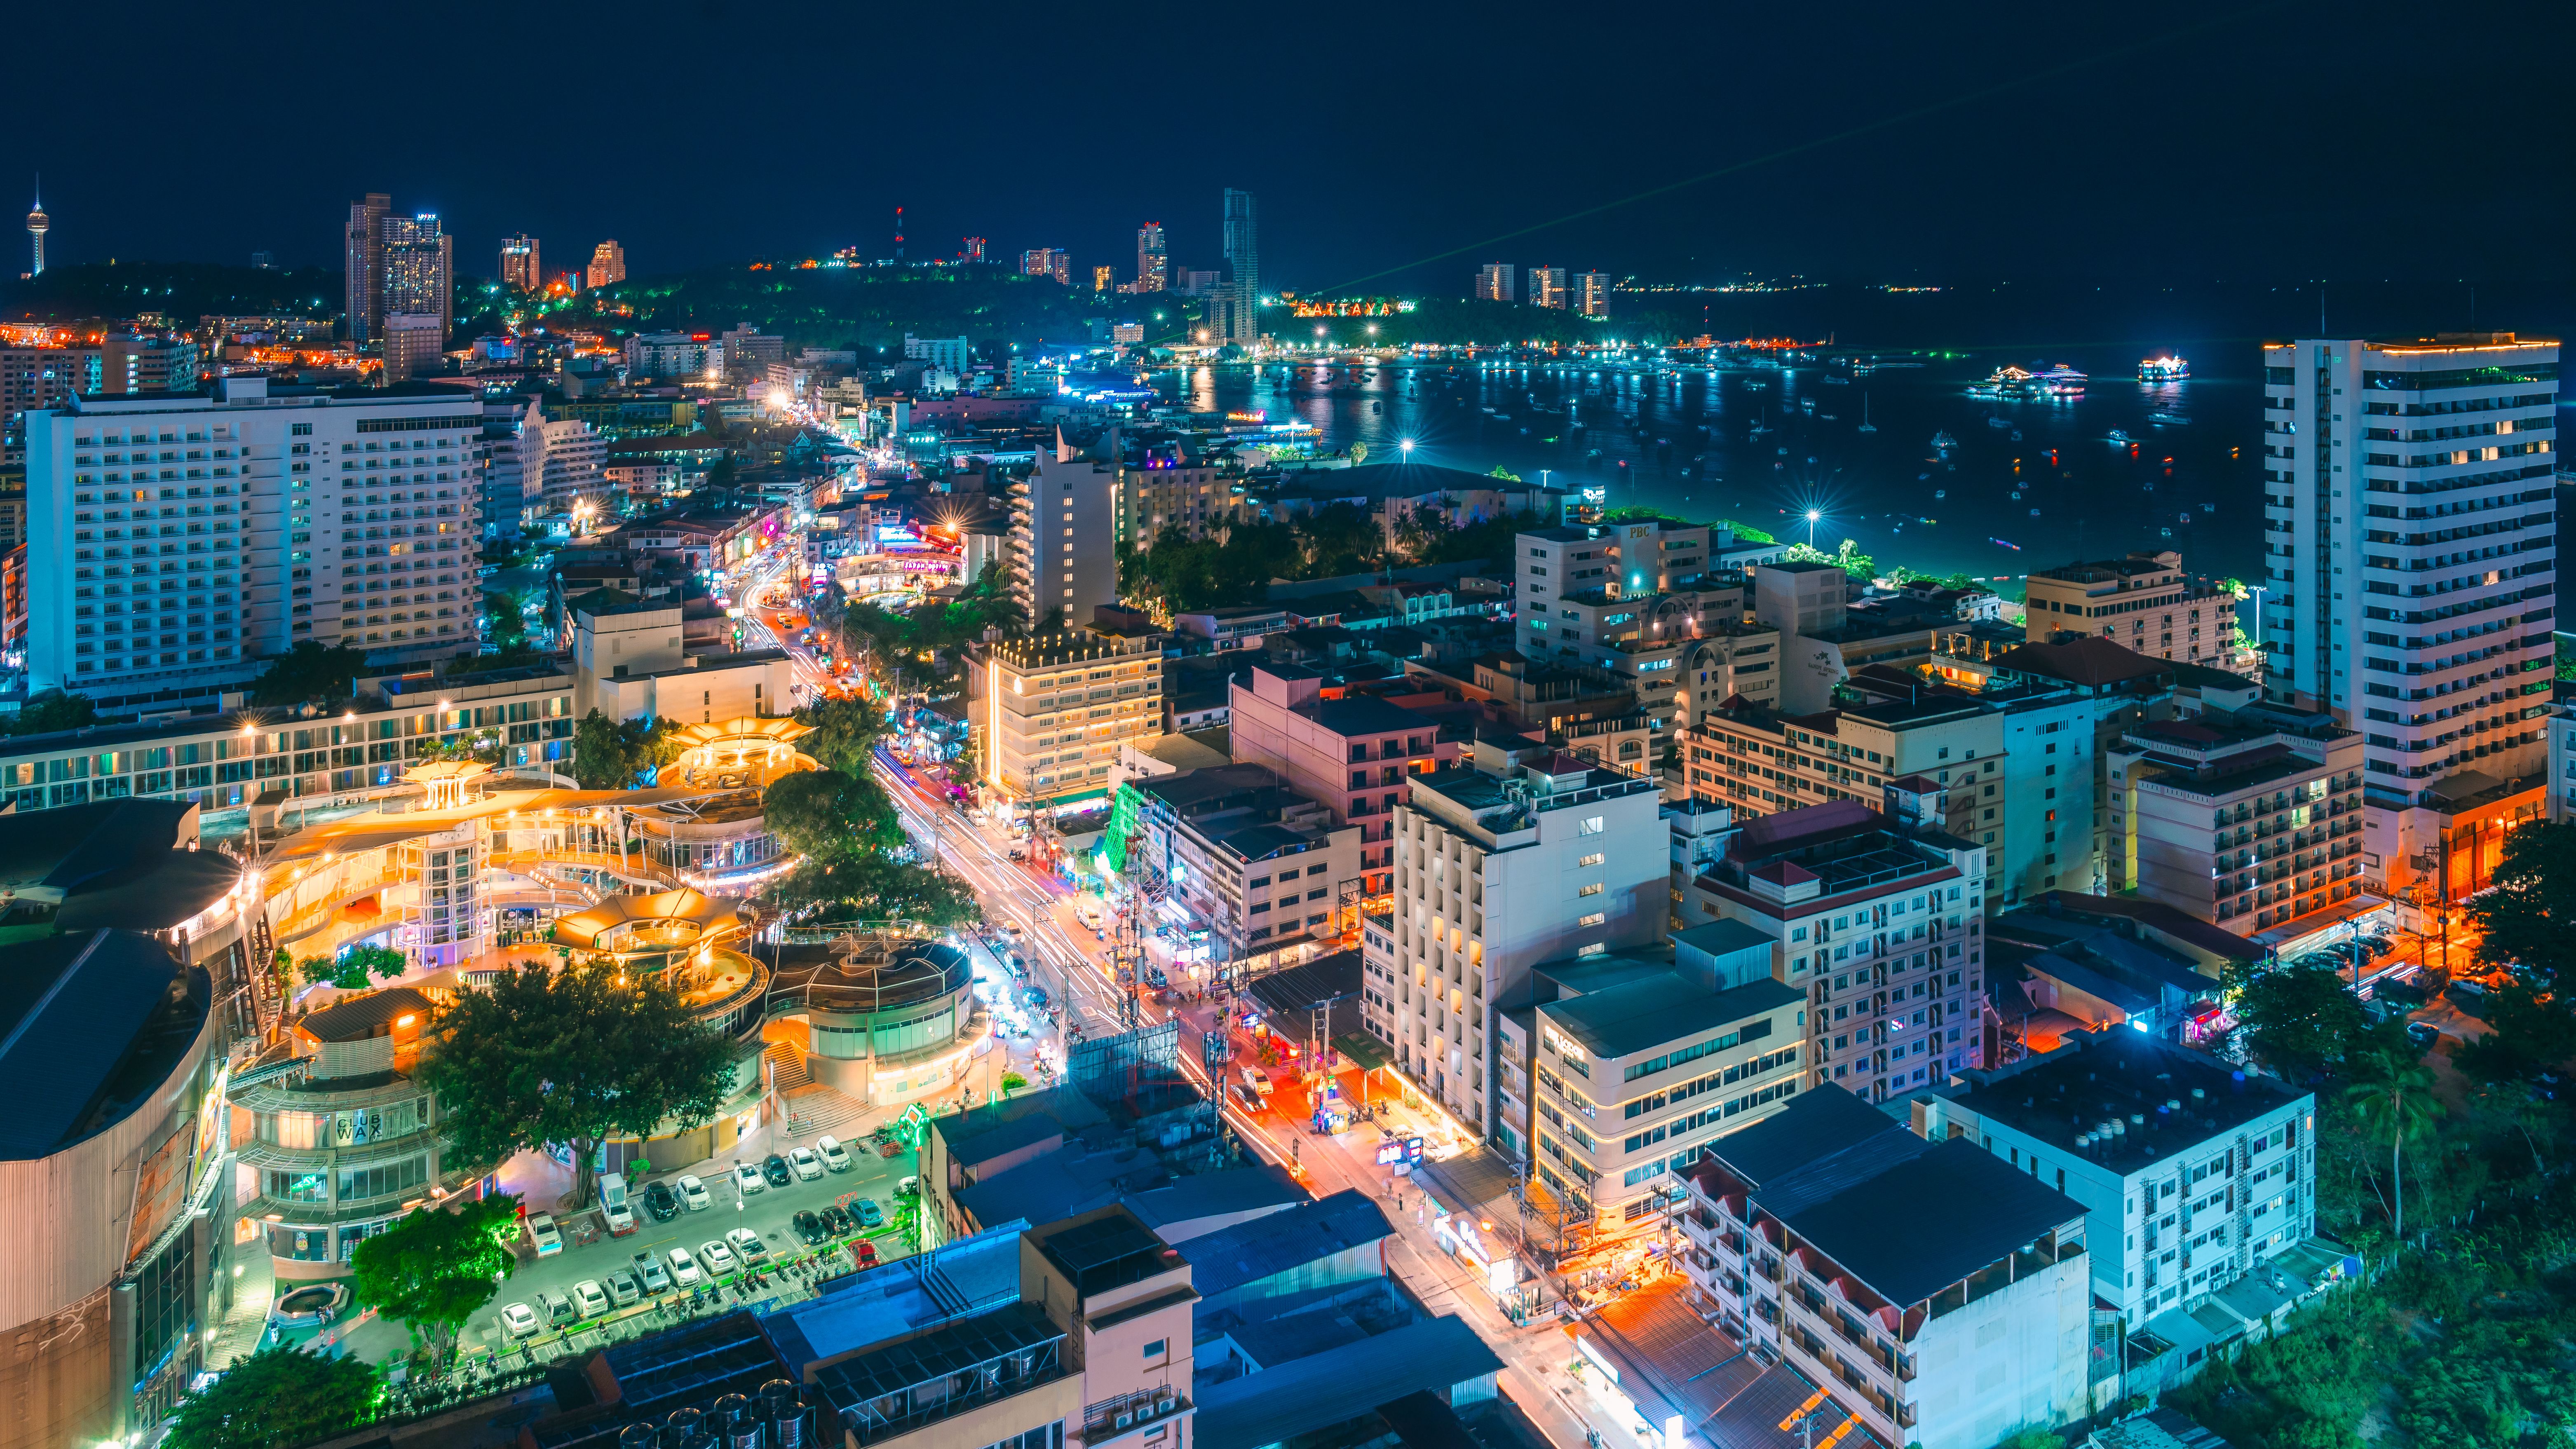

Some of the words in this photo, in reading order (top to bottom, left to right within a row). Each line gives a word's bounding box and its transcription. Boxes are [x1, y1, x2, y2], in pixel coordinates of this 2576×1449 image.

[1300, 302, 1389, 316] PATTAYA
[1397, 301, 1415, 310] city
[1630, 526, 1650, 538] PBC
[338, 1114, 380, 1128] CLUB
[338, 1124, 380, 1140] WAX
